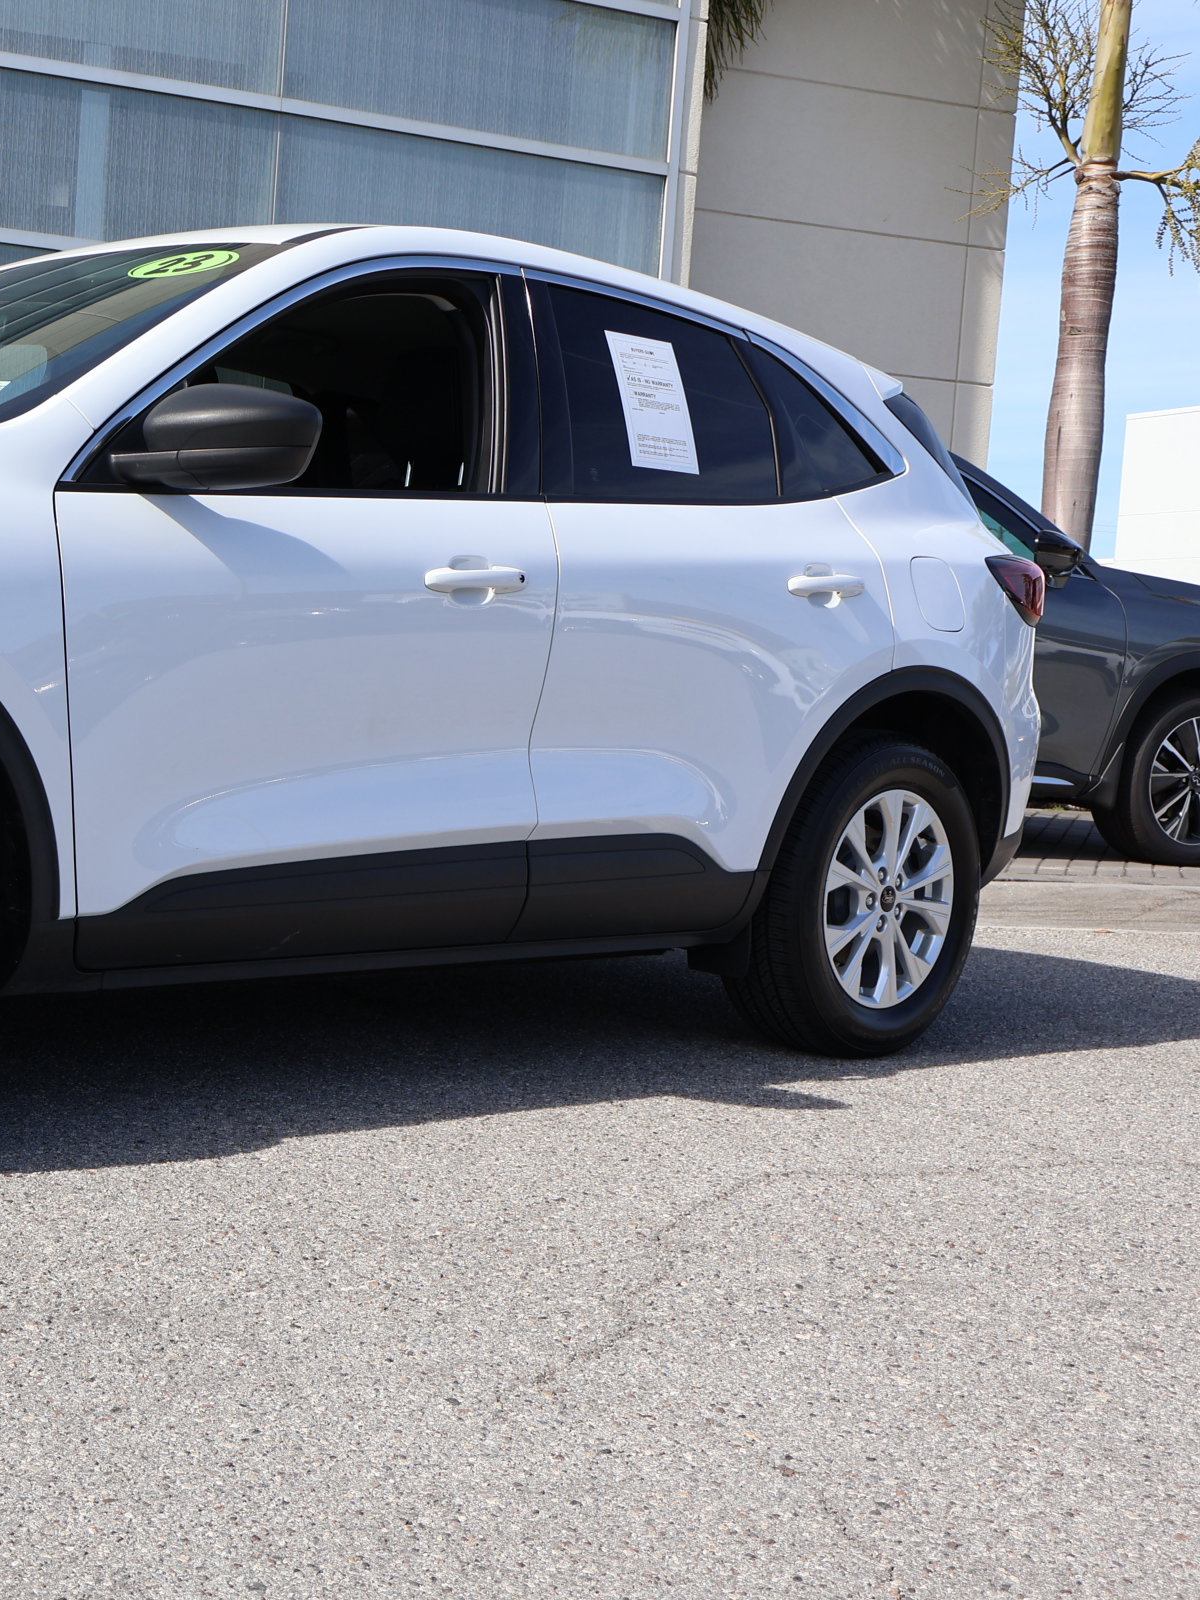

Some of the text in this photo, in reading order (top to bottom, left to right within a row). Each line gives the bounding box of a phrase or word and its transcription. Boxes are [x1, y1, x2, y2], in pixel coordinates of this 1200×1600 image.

[143, 254, 215, 276] 23
[652, 380, 673, 388] WARRANTY
[634, 391, 656, 399] WARRANTY
[911, 756, 945, 777] SEASON
